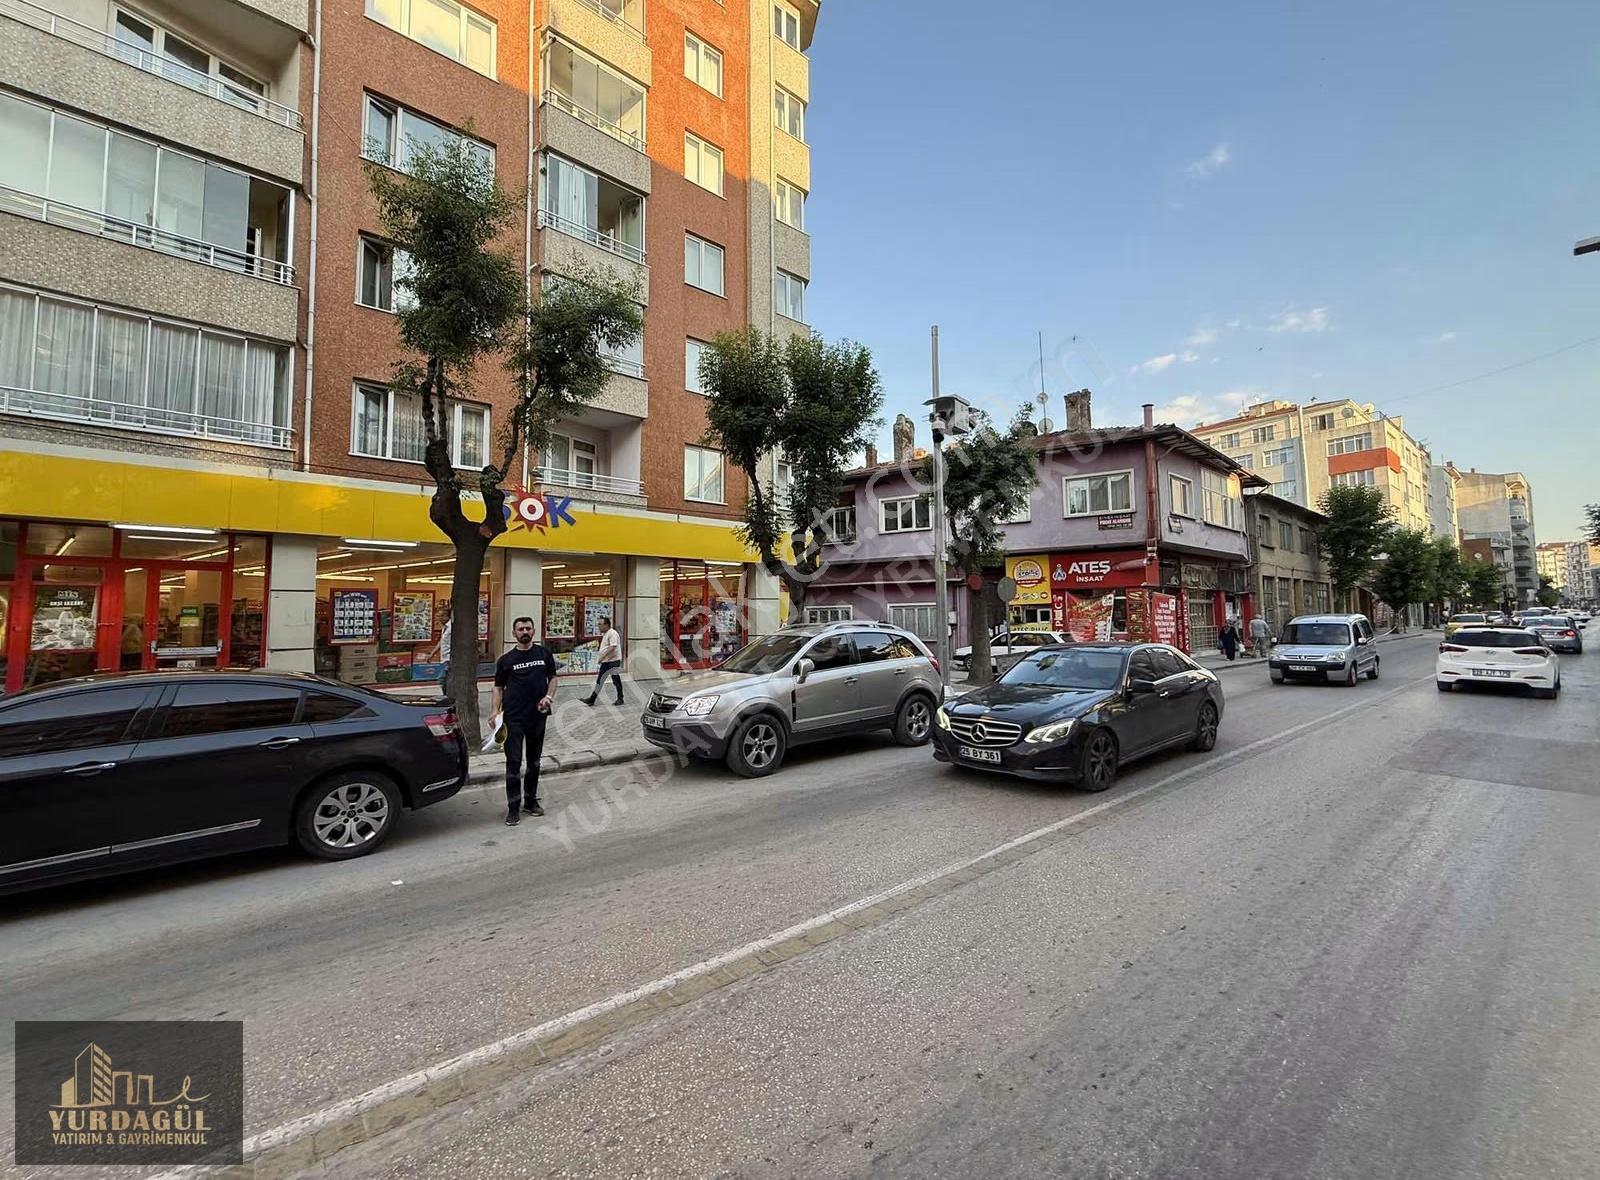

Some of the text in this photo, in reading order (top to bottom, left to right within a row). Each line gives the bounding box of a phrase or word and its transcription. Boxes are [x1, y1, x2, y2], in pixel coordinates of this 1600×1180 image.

[1068, 560, 1110, 574] ATEŞ
[513, 660, 545, 670] HILFIGER
[985, 751, 999, 760] 361
